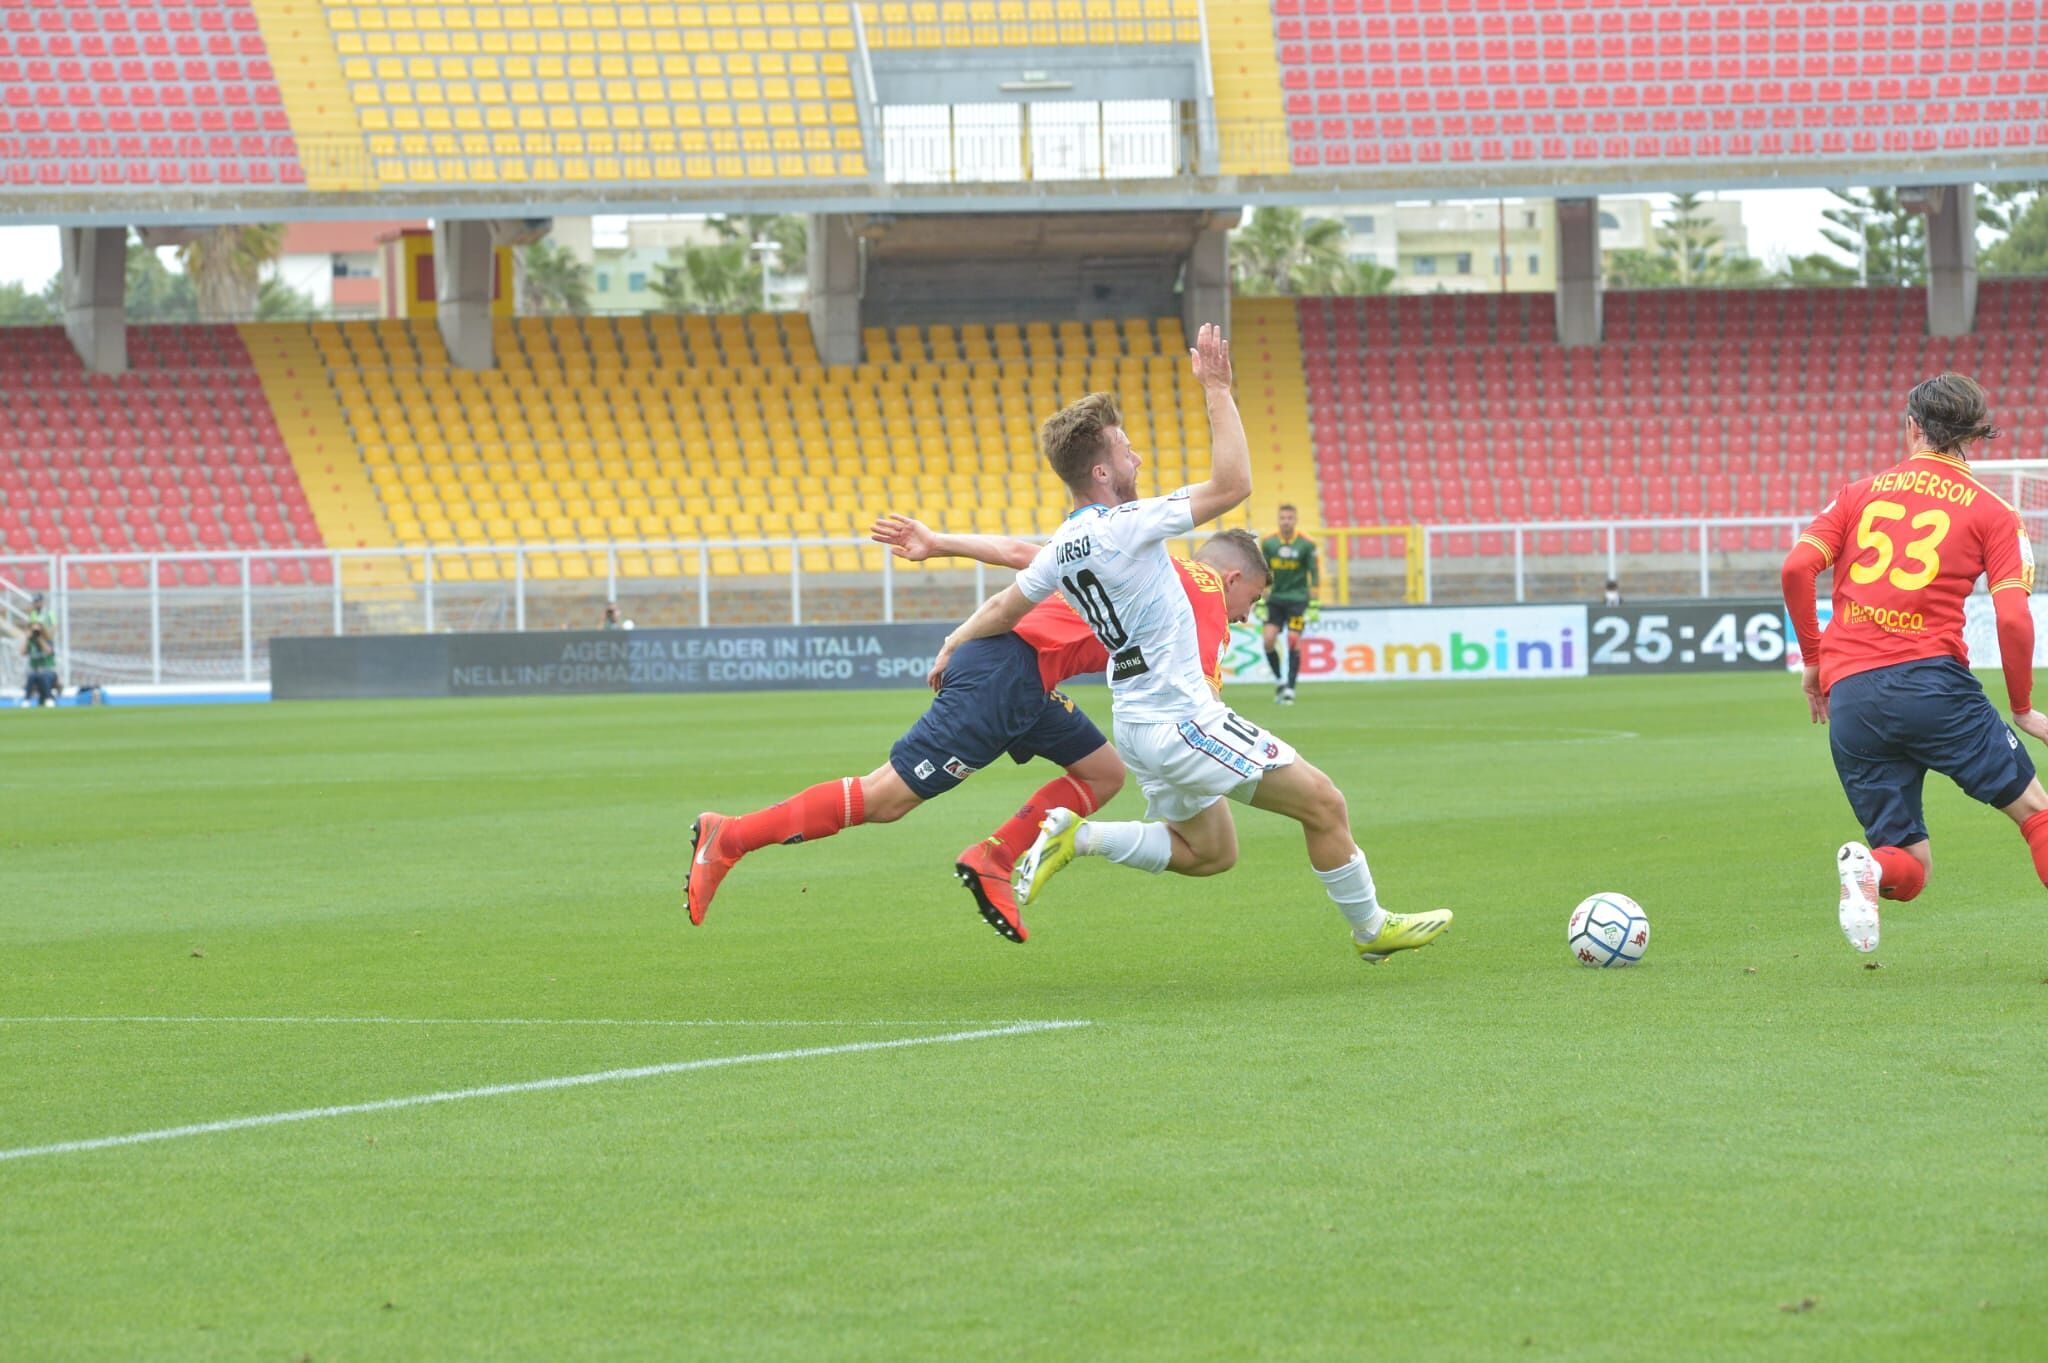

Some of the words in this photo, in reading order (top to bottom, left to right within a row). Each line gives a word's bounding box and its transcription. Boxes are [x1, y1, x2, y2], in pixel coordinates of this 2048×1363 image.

[1871, 470, 1978, 507] HENDERSON
[1850, 500, 1950, 591] 53
[1062, 569, 1128, 650] 10
[1307, 619, 1360, 632] ome
[561, 640, 667, 662] AGENZIA
[671, 638, 767, 660] LEADER
[774, 637, 798, 658] IN
[806, 636, 883, 657] ITALIA
[1299, 629, 1574, 674] Bambini
[1592, 612, 1784, 664] 25:46
[453, 661, 699, 686] NELL'INFORMAZIONE
[708, 659, 853, 681] ECONOMICO
